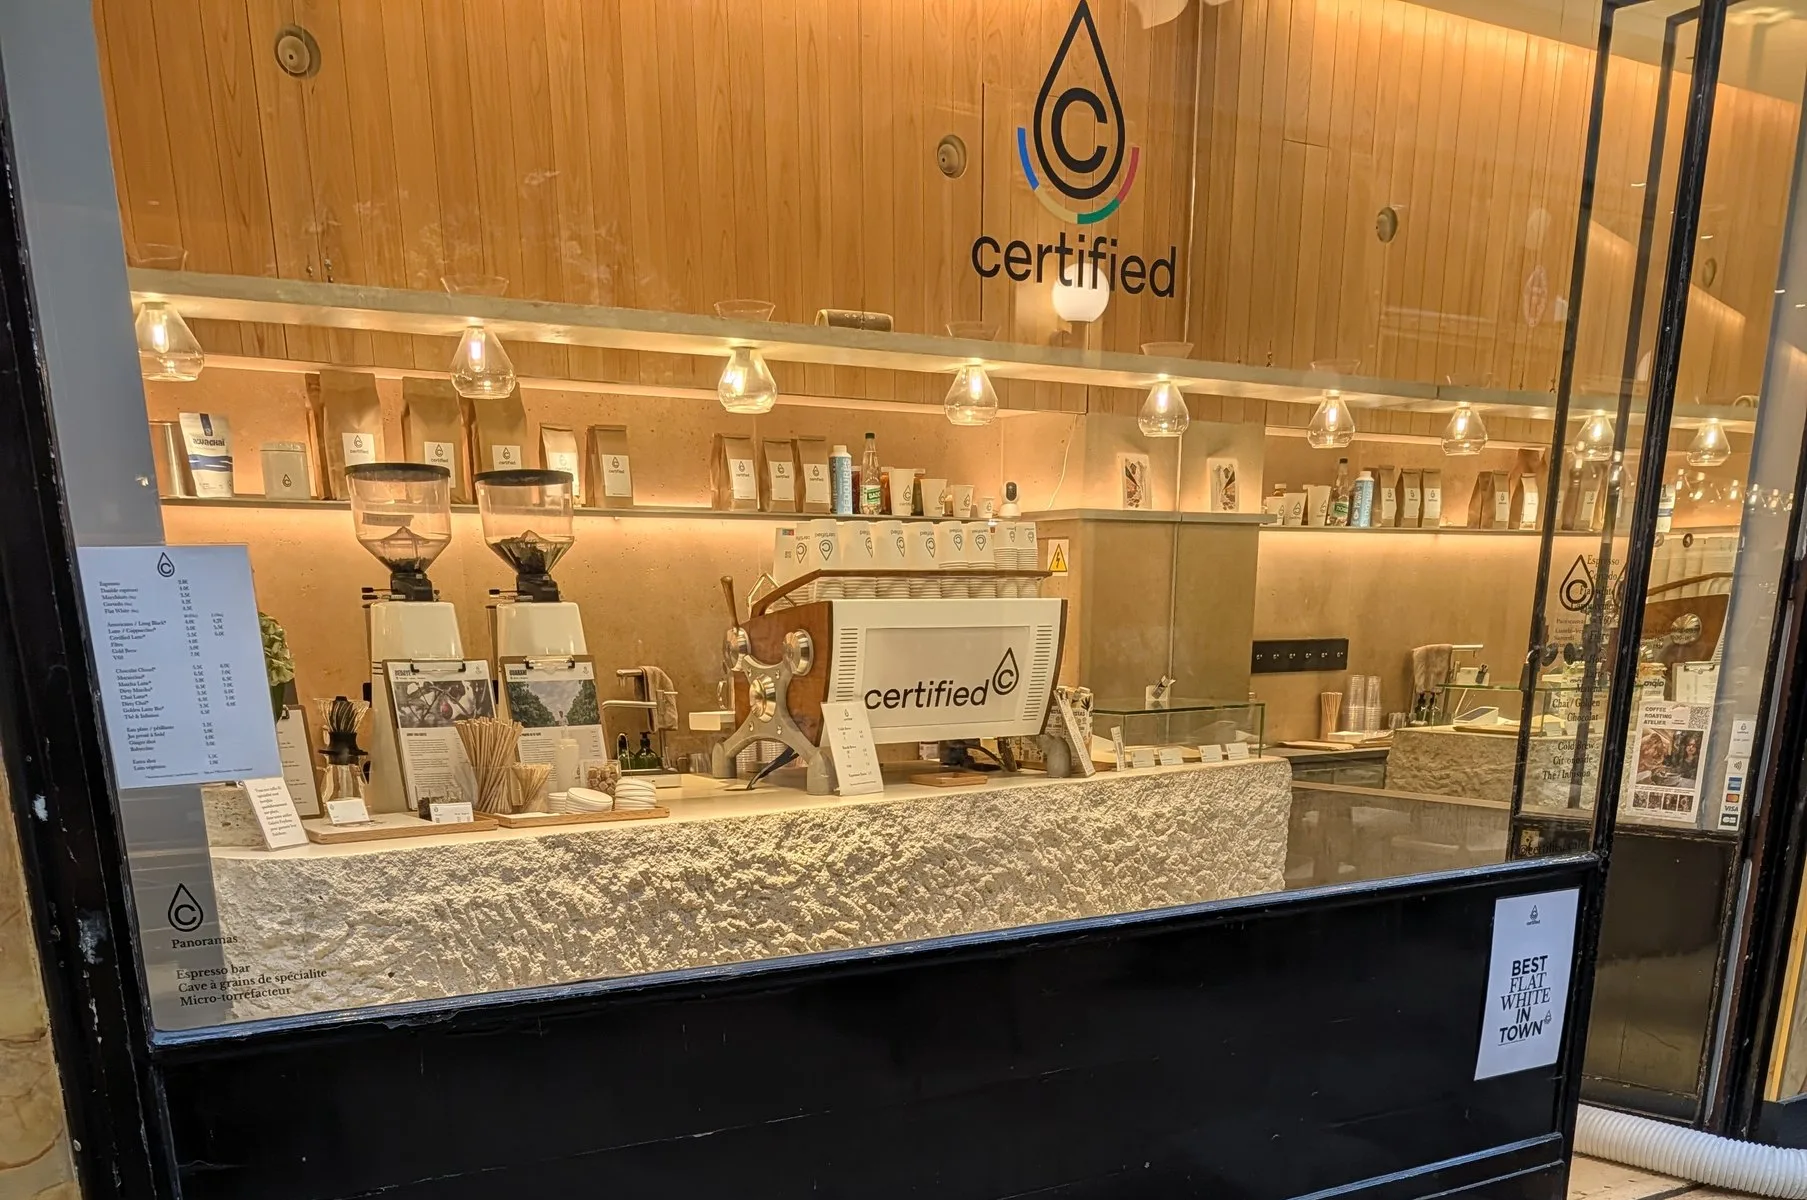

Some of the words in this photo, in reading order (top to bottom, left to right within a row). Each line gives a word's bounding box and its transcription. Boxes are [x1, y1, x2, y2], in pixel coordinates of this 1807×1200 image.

[972, 232, 1176, 298] certified
[864, 679, 989, 710] certified
[1552, 698, 1569, 708] Chai
[1567, 711, 1599, 722] Chocolat
[1557, 741, 1575, 751] Cold
[171, 935, 238, 949] Panoramas
[176, 967, 228, 981] Espresso
[231, 964, 250, 974] bar
[1511, 955, 1548, 977] BEST
[178, 981, 208, 993] Cave
[210, 978, 217, 990] à
[220, 975, 256, 992] grains
[258, 974, 272, 985] de
[1509, 972, 1547, 994] FLAT
[1500, 987, 1551, 1011] WHITE
[1516, 1007, 1531, 1024] IN
[1499, 1020, 1544, 1043] TOWN
